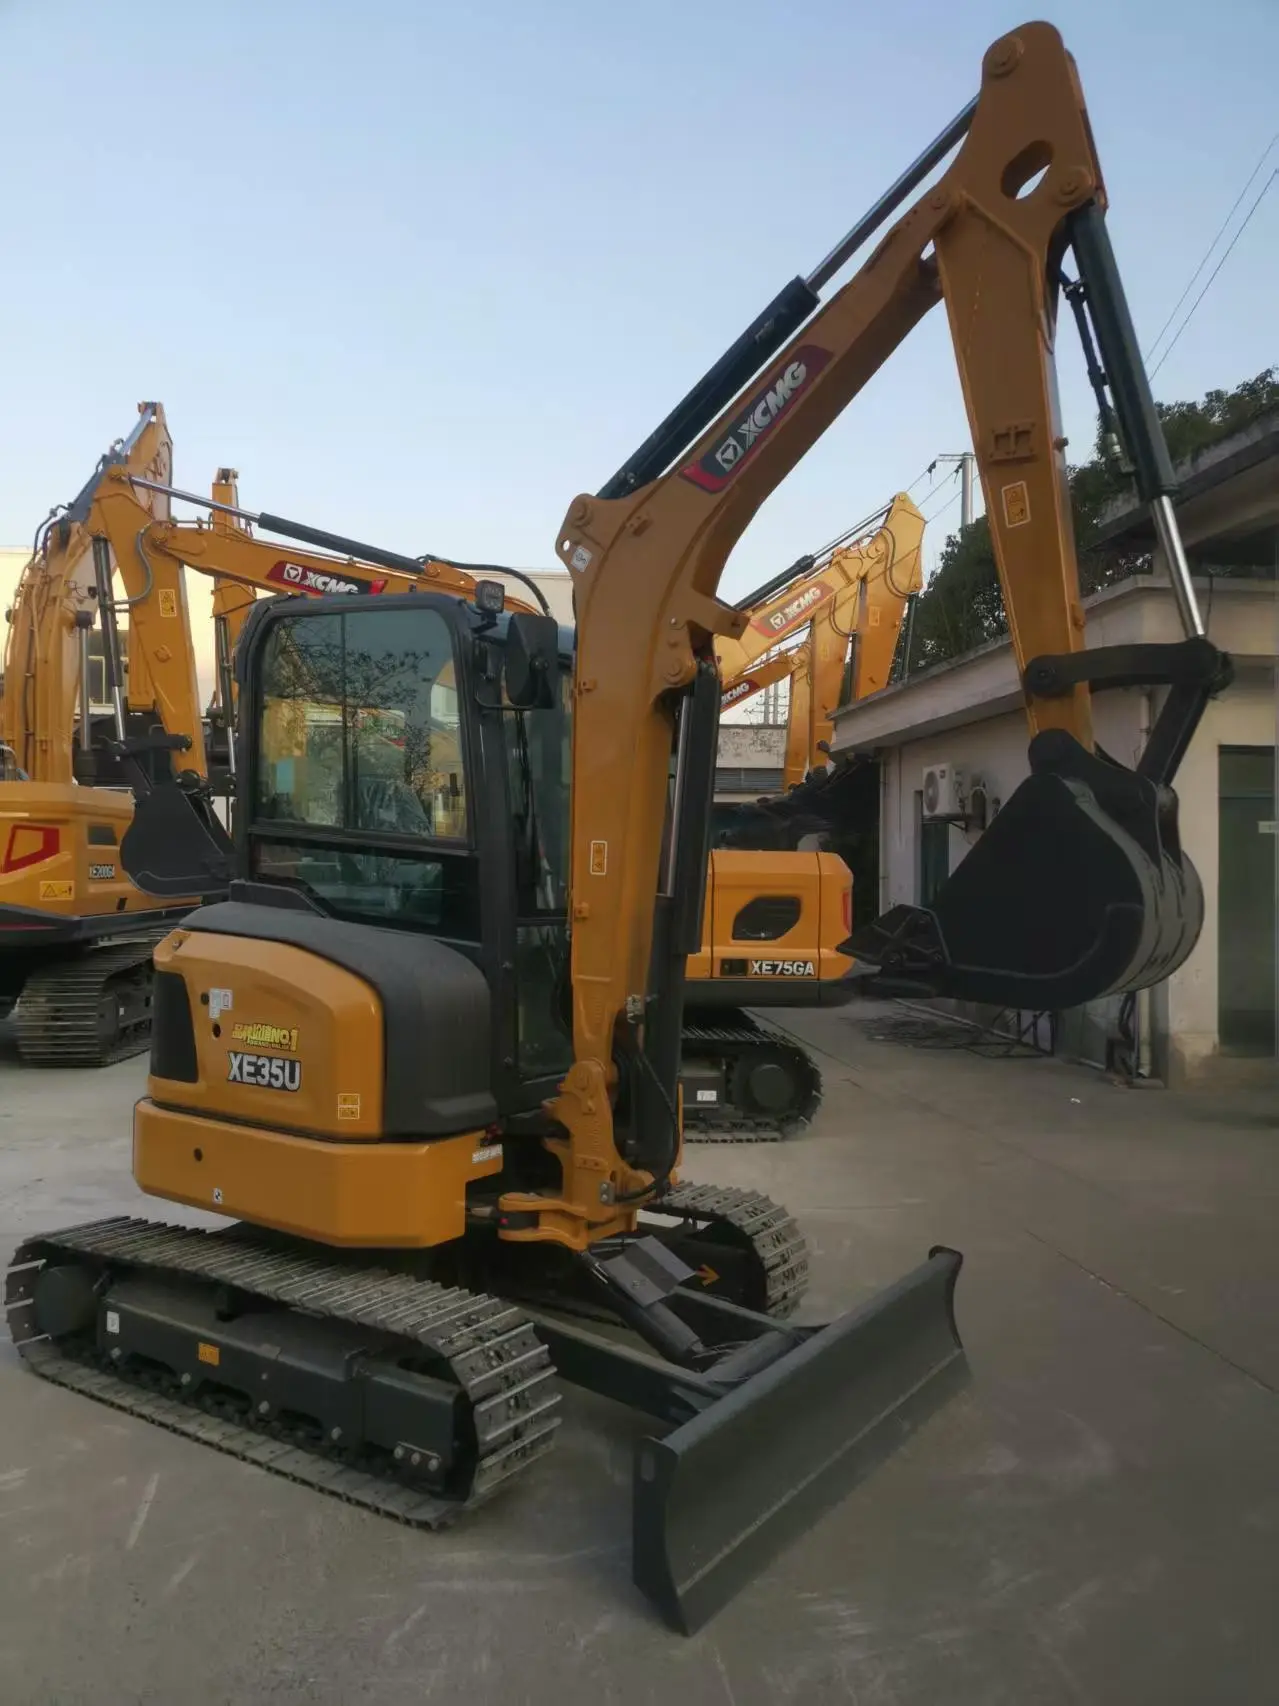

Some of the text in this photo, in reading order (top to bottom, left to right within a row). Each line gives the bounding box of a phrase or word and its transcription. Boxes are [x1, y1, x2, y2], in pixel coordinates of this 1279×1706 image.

[737, 361, 807, 449] XCMG
[301, 570, 359, 594] XCMG
[783, 586, 821, 621] XCMG
[751, 960, 815, 976] XE75GA
[228, 1051, 301, 1091] XE35U
